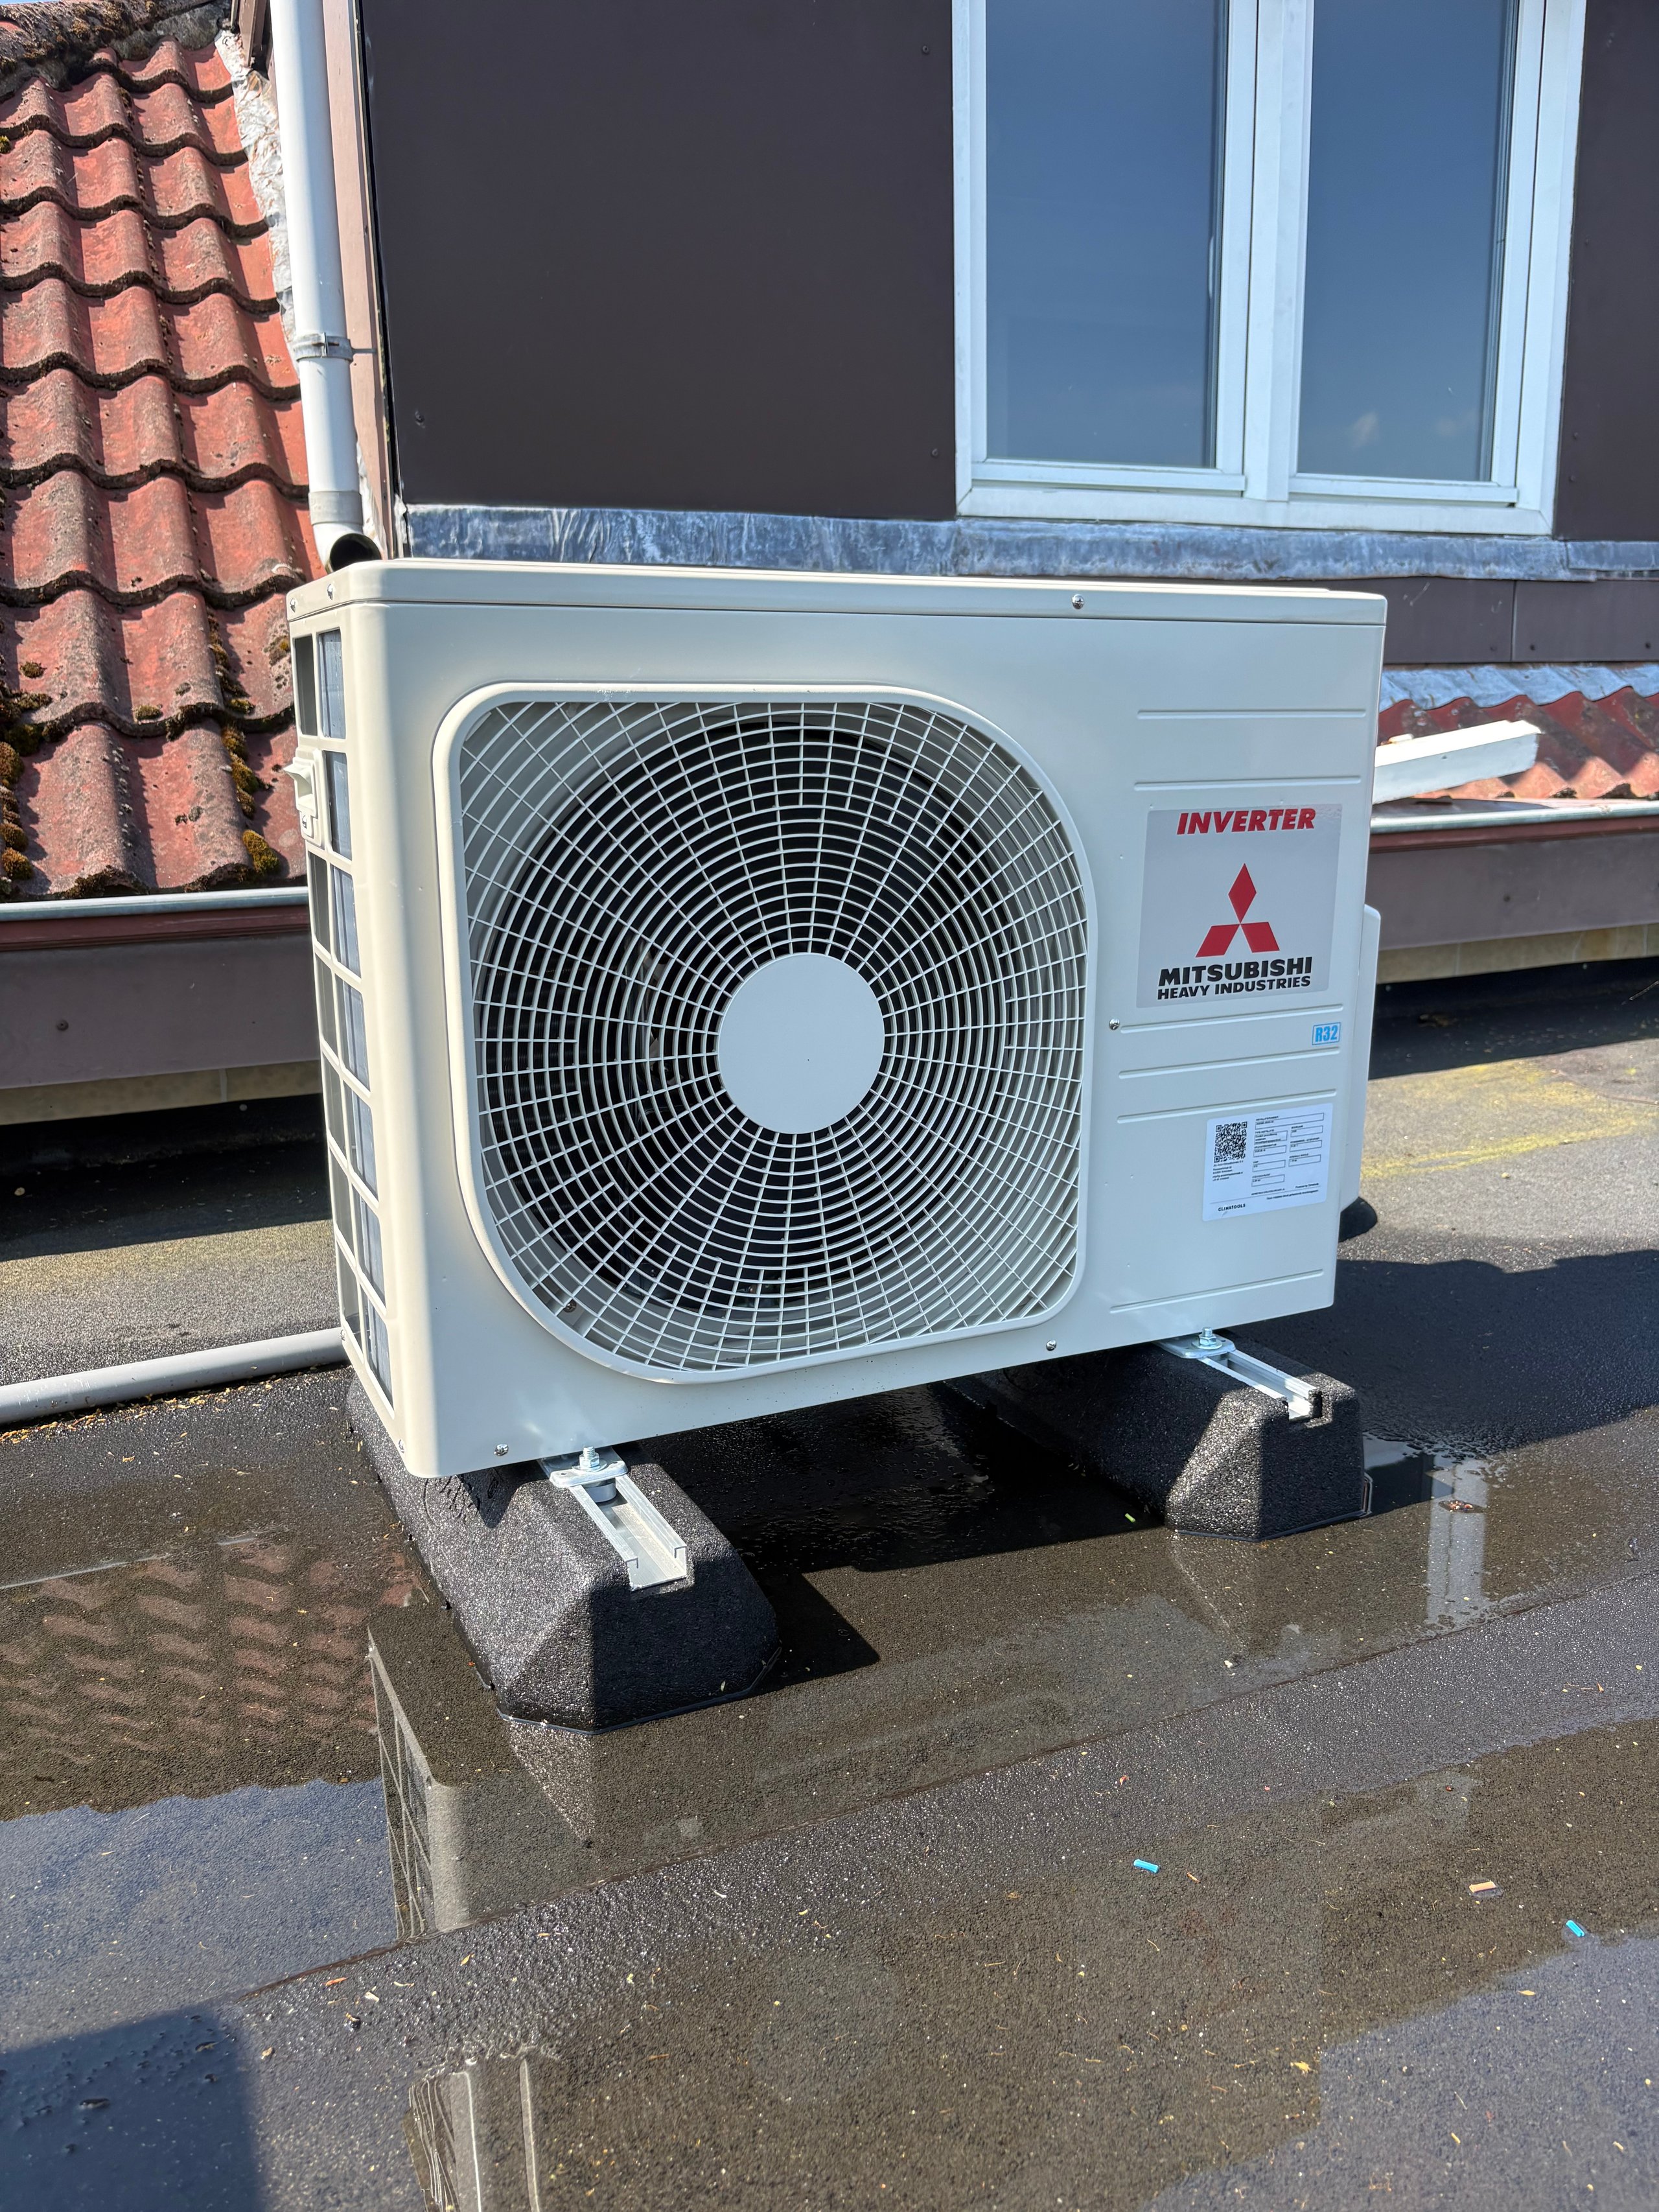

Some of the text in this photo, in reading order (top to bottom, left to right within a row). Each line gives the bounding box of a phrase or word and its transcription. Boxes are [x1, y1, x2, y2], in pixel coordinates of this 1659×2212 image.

[1177, 808, 1316, 835] INVERTER
[1158, 957, 1313, 987] MITSUBISHI
[1157, 975, 1310, 1000] HEAVY INDUSTRIES
[1315, 1025, 1339, 1043] R32
[1218, 1203, 1246, 1211] CLIMATOOLS
